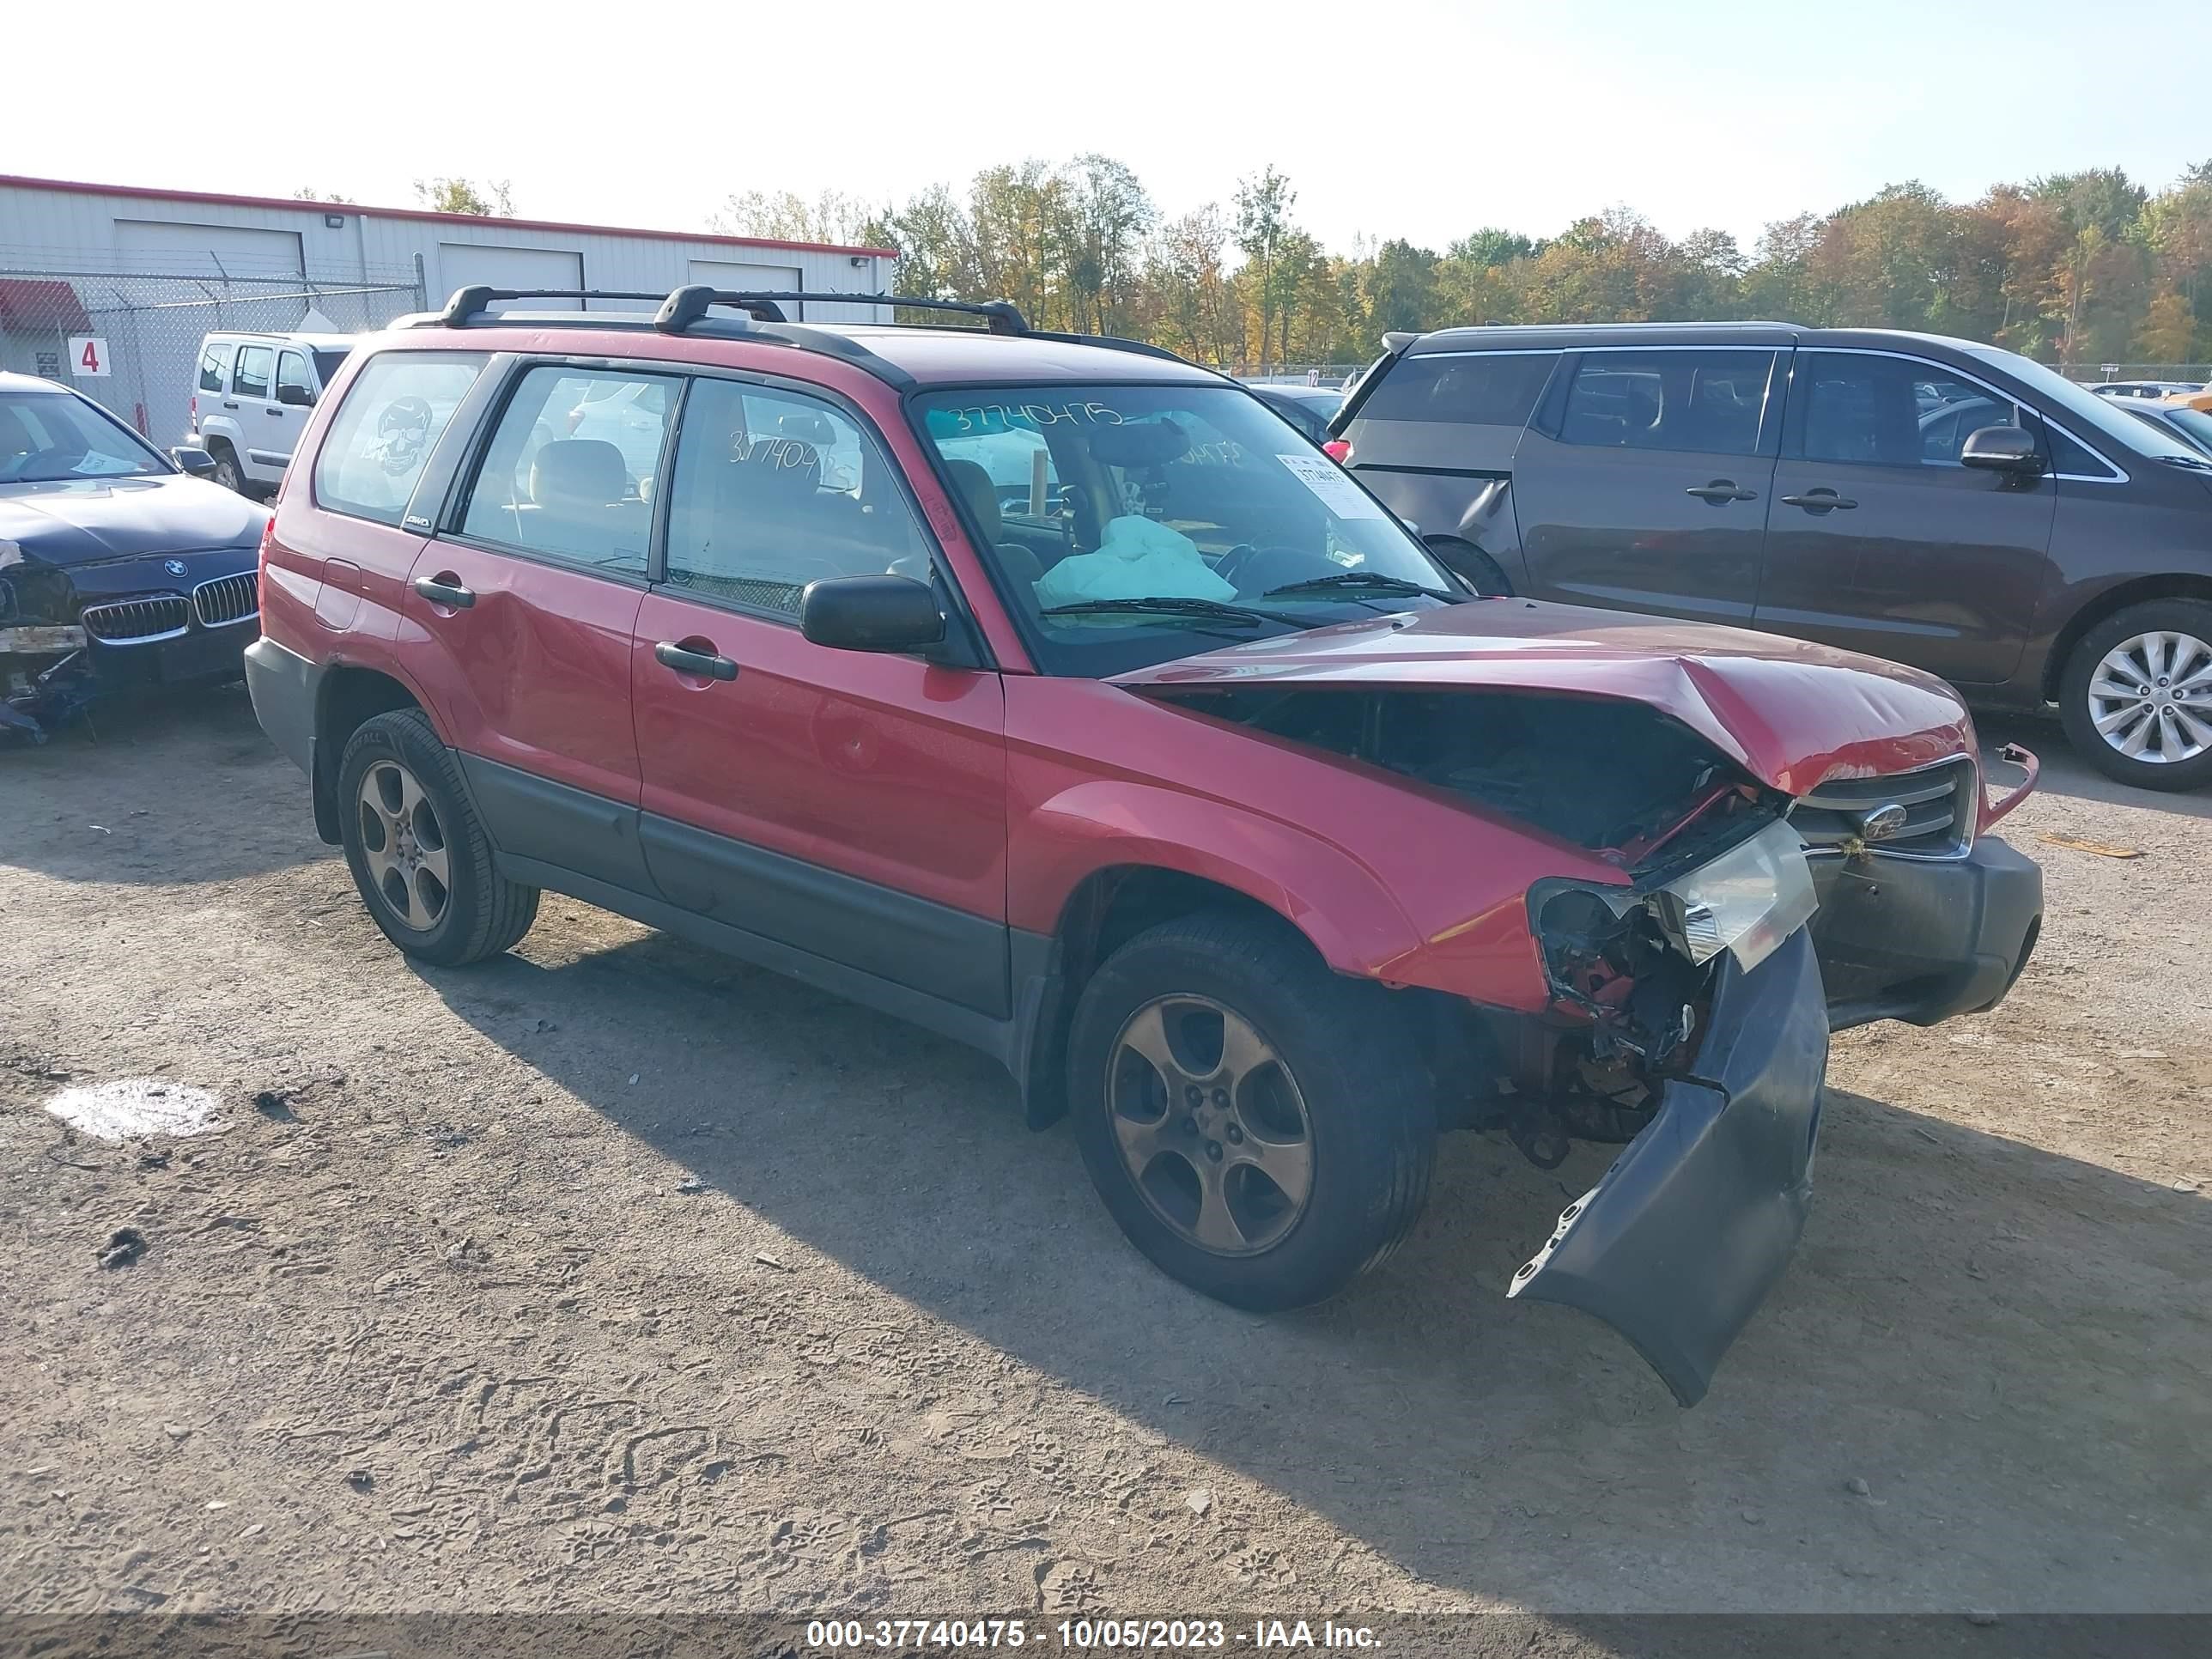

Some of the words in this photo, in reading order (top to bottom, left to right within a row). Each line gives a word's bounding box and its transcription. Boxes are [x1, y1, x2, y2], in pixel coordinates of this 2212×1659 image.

[82, 342, 99, 372] 4
[1309, 371, 1319, 387] 12
[948, 403, 1123, 430] 37740475
